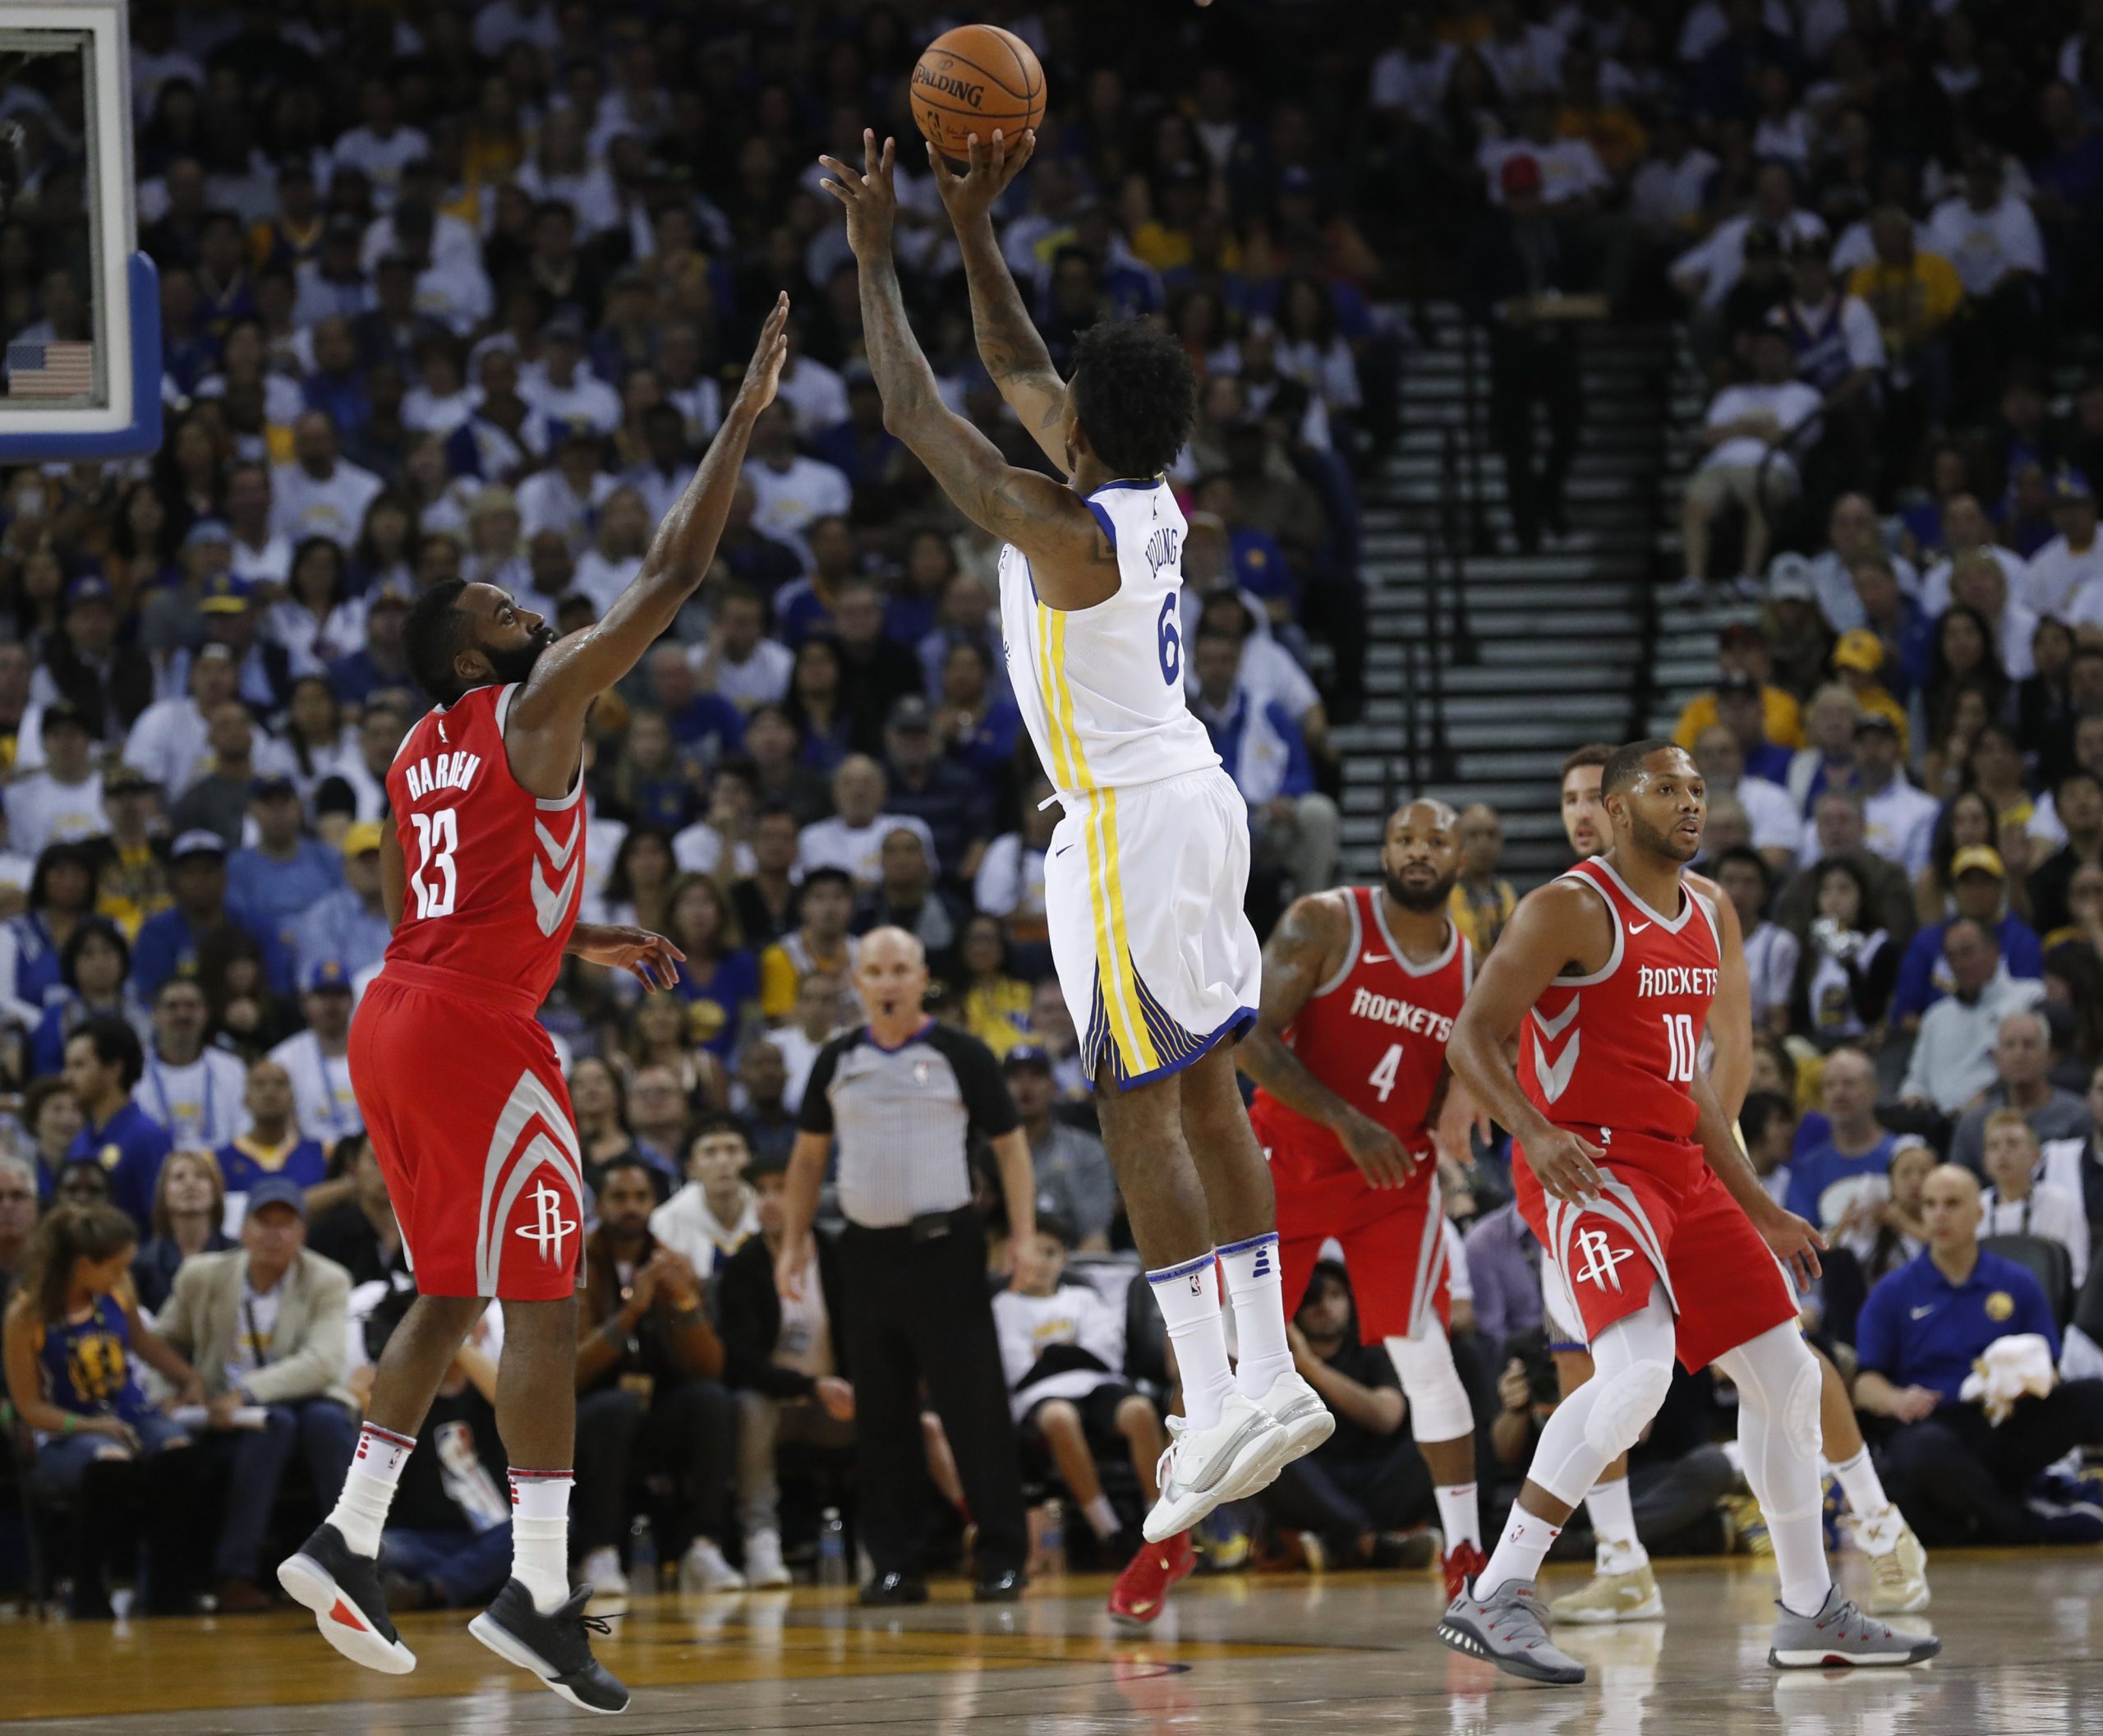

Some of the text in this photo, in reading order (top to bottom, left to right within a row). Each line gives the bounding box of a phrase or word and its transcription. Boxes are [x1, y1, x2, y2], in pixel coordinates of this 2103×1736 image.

[912, 63, 984, 108] SPALDING
[1145, 528, 1177, 578] YOUNG
[1157, 592, 1180, 685] 6
[406, 751, 481, 801] HARDEN
[411, 808, 458, 919] 13
[1637, 965, 1718, 997] ROCKETS
[1350, 986, 1453, 1042] ROCKETS
[1368, 1043, 1403, 1103] 4
[1663, 1014, 1696, 1081] 10
